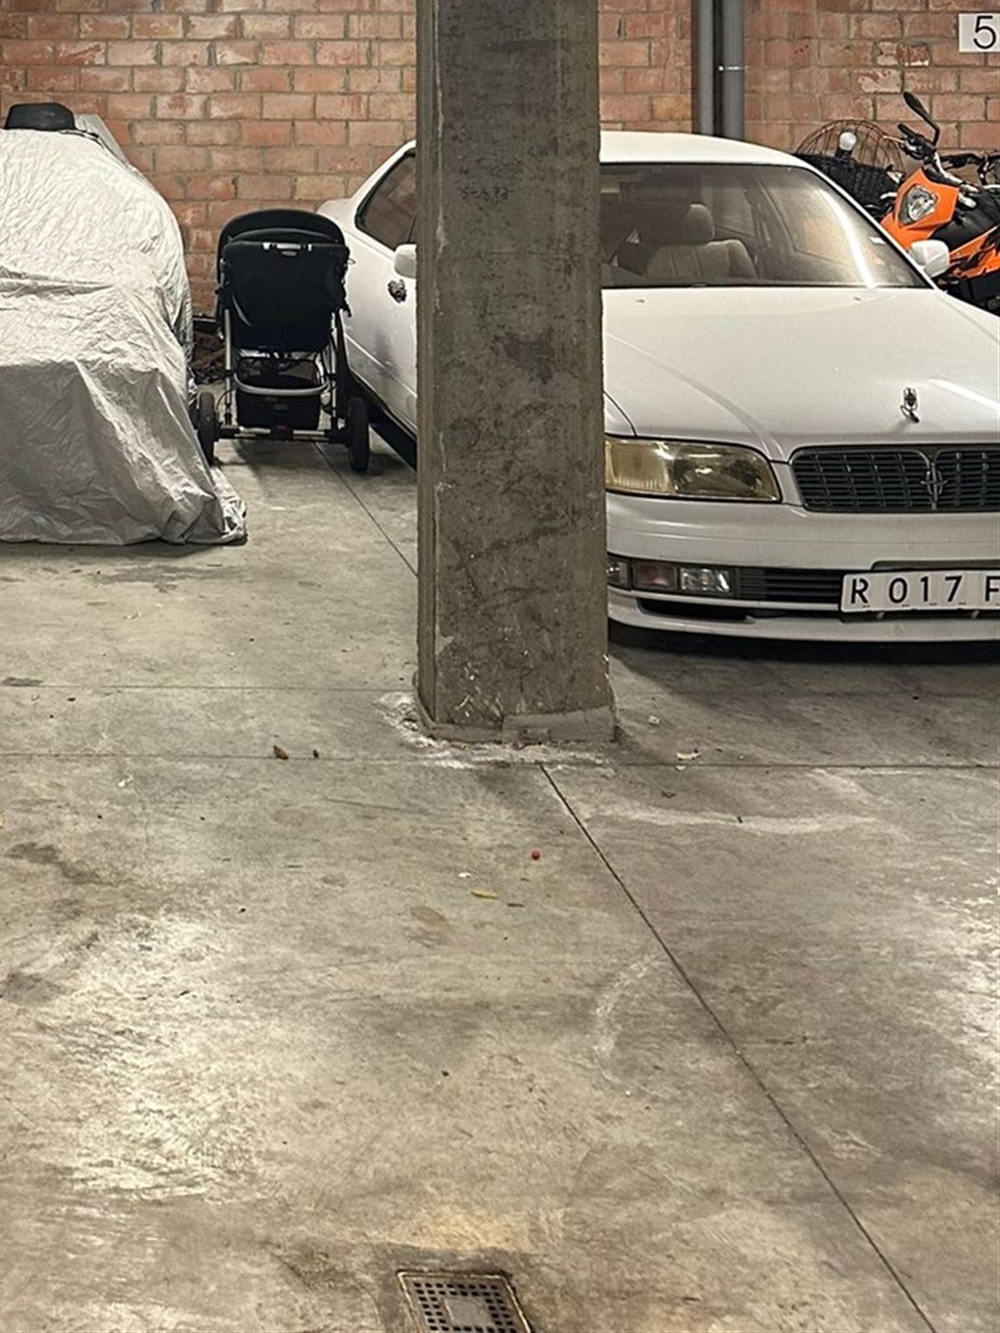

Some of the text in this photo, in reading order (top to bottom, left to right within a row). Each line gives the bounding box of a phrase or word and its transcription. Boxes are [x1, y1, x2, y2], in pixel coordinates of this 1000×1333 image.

[973, 15, 996, 49] 5
[851, 578, 869, 604] R
[888, 576, 963, 604] 017
